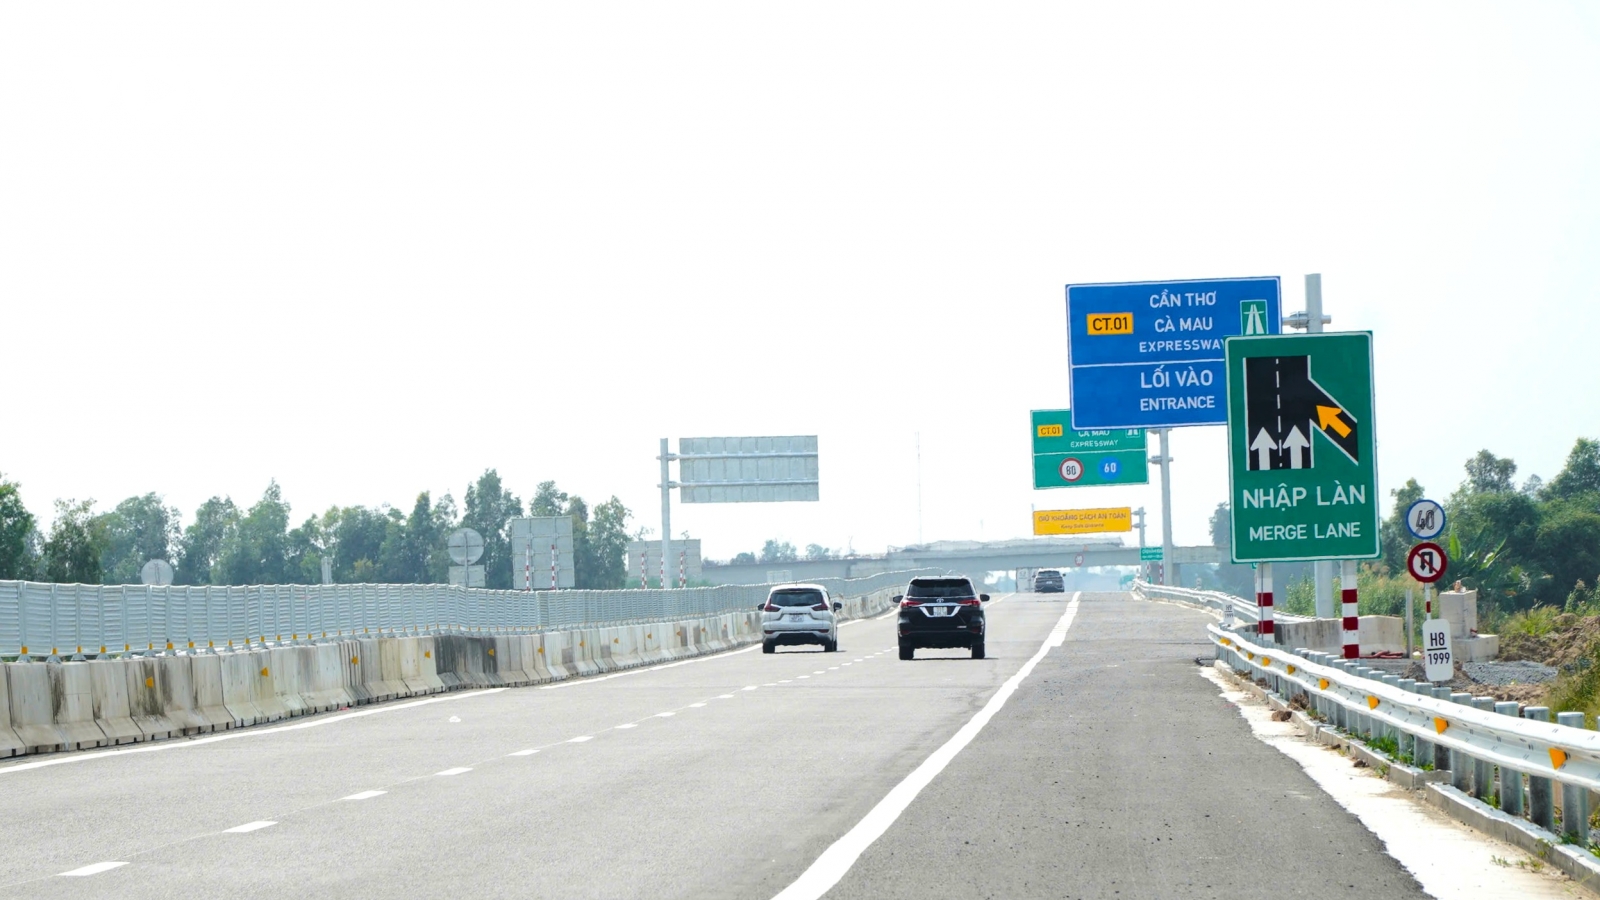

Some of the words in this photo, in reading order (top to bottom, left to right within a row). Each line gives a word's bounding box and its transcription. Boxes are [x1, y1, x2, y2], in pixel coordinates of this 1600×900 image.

[1150, 289, 1180, 308] CẦN
[1185, 291, 1217, 306] THƠ
[1092, 317, 1128, 331] CT.01
[1154, 315, 1175, 332] CÀ
[1180, 317, 1213, 331] MAU
[1140, 365, 1169, 388] LỐI
[1175, 366, 1213, 387] VÀO
[1140, 396, 1215, 411] ENTRANCE
[1041, 427, 1060, 435] CT.01
[1070, 440, 1119, 448] EXPRESSWAY
[1066, 465, 1077, 476] 80
[1104, 462, 1117, 473] 60
[1243, 483, 1307, 511] NHẬP
[1316, 480, 1365, 506] LÀN
[1415, 510, 1435, 530] 40
[1249, 524, 1308, 541] MERGE
[1314, 522, 1361, 539] LANE
[1430, 632, 1445, 647] H8
[1428, 652, 1450, 665] 1999
